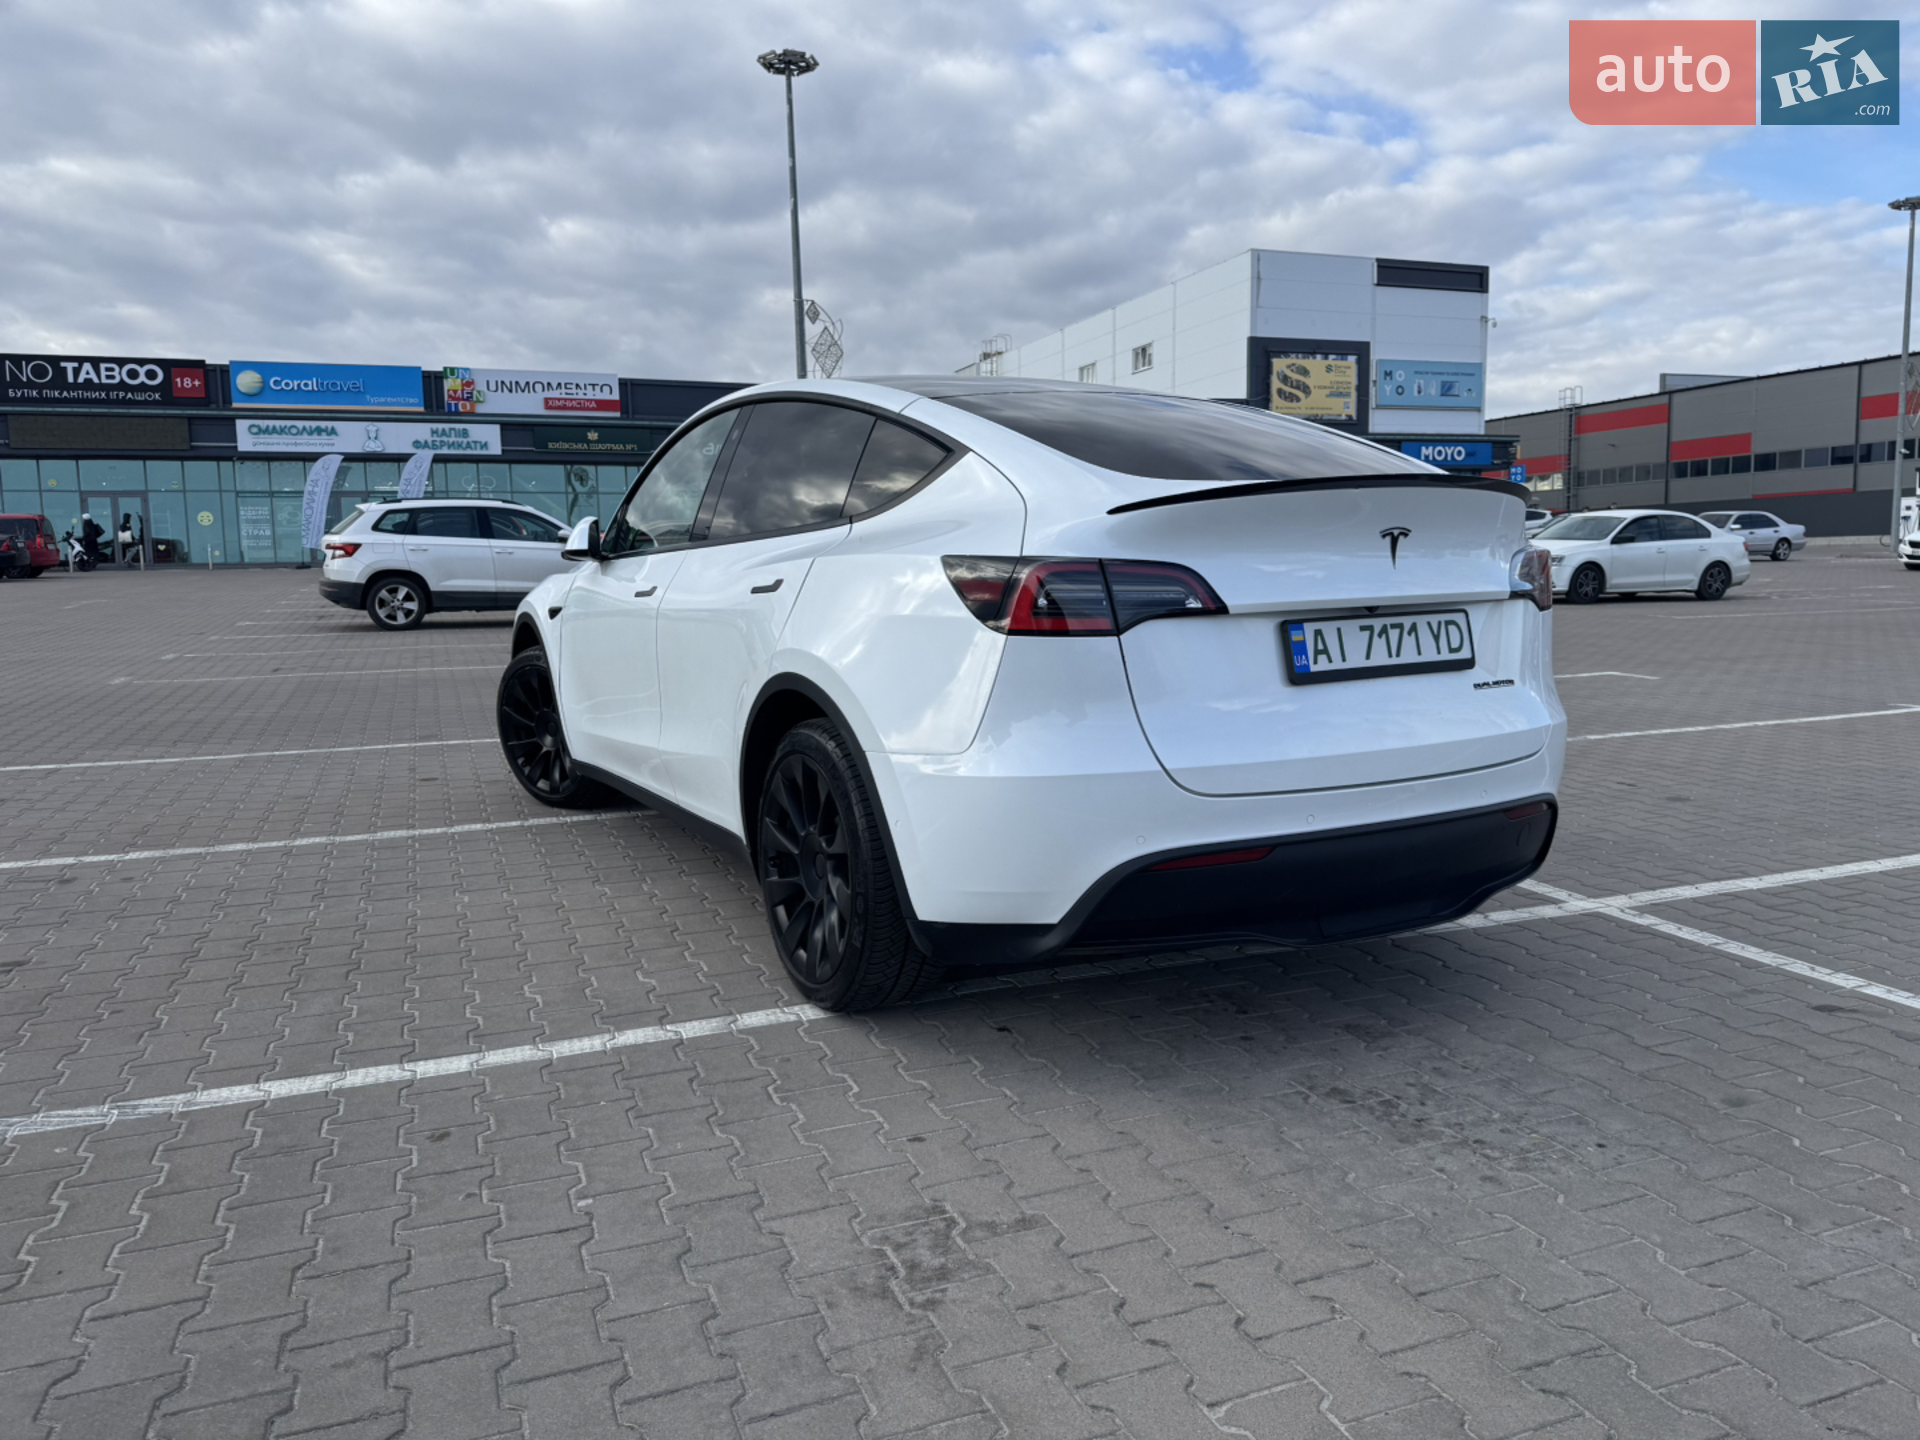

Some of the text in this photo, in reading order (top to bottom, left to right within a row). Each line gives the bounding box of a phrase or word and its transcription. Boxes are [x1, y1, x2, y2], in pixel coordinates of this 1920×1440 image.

[5, 360, 165, 386] NO TABOO
[175, 377, 202, 389] 18+
[486, 379, 613, 397] UNMOMENTO
[8, 388, 163, 401] БУТІК ПІКАНТНИХ ІГРАШОК
[547, 399, 597, 409] ХІМЧИСТКА
[247, 424, 339, 436] СМАКОЛИНА
[430, 427, 470, 438] НАПІВ
[412, 440, 489, 451] ФАБРИКАТИ
[1420, 446, 1466, 461] MOYO
[1312, 619, 1465, 665] AI 7171 YD
[1293, 654, 1309, 667] UA
